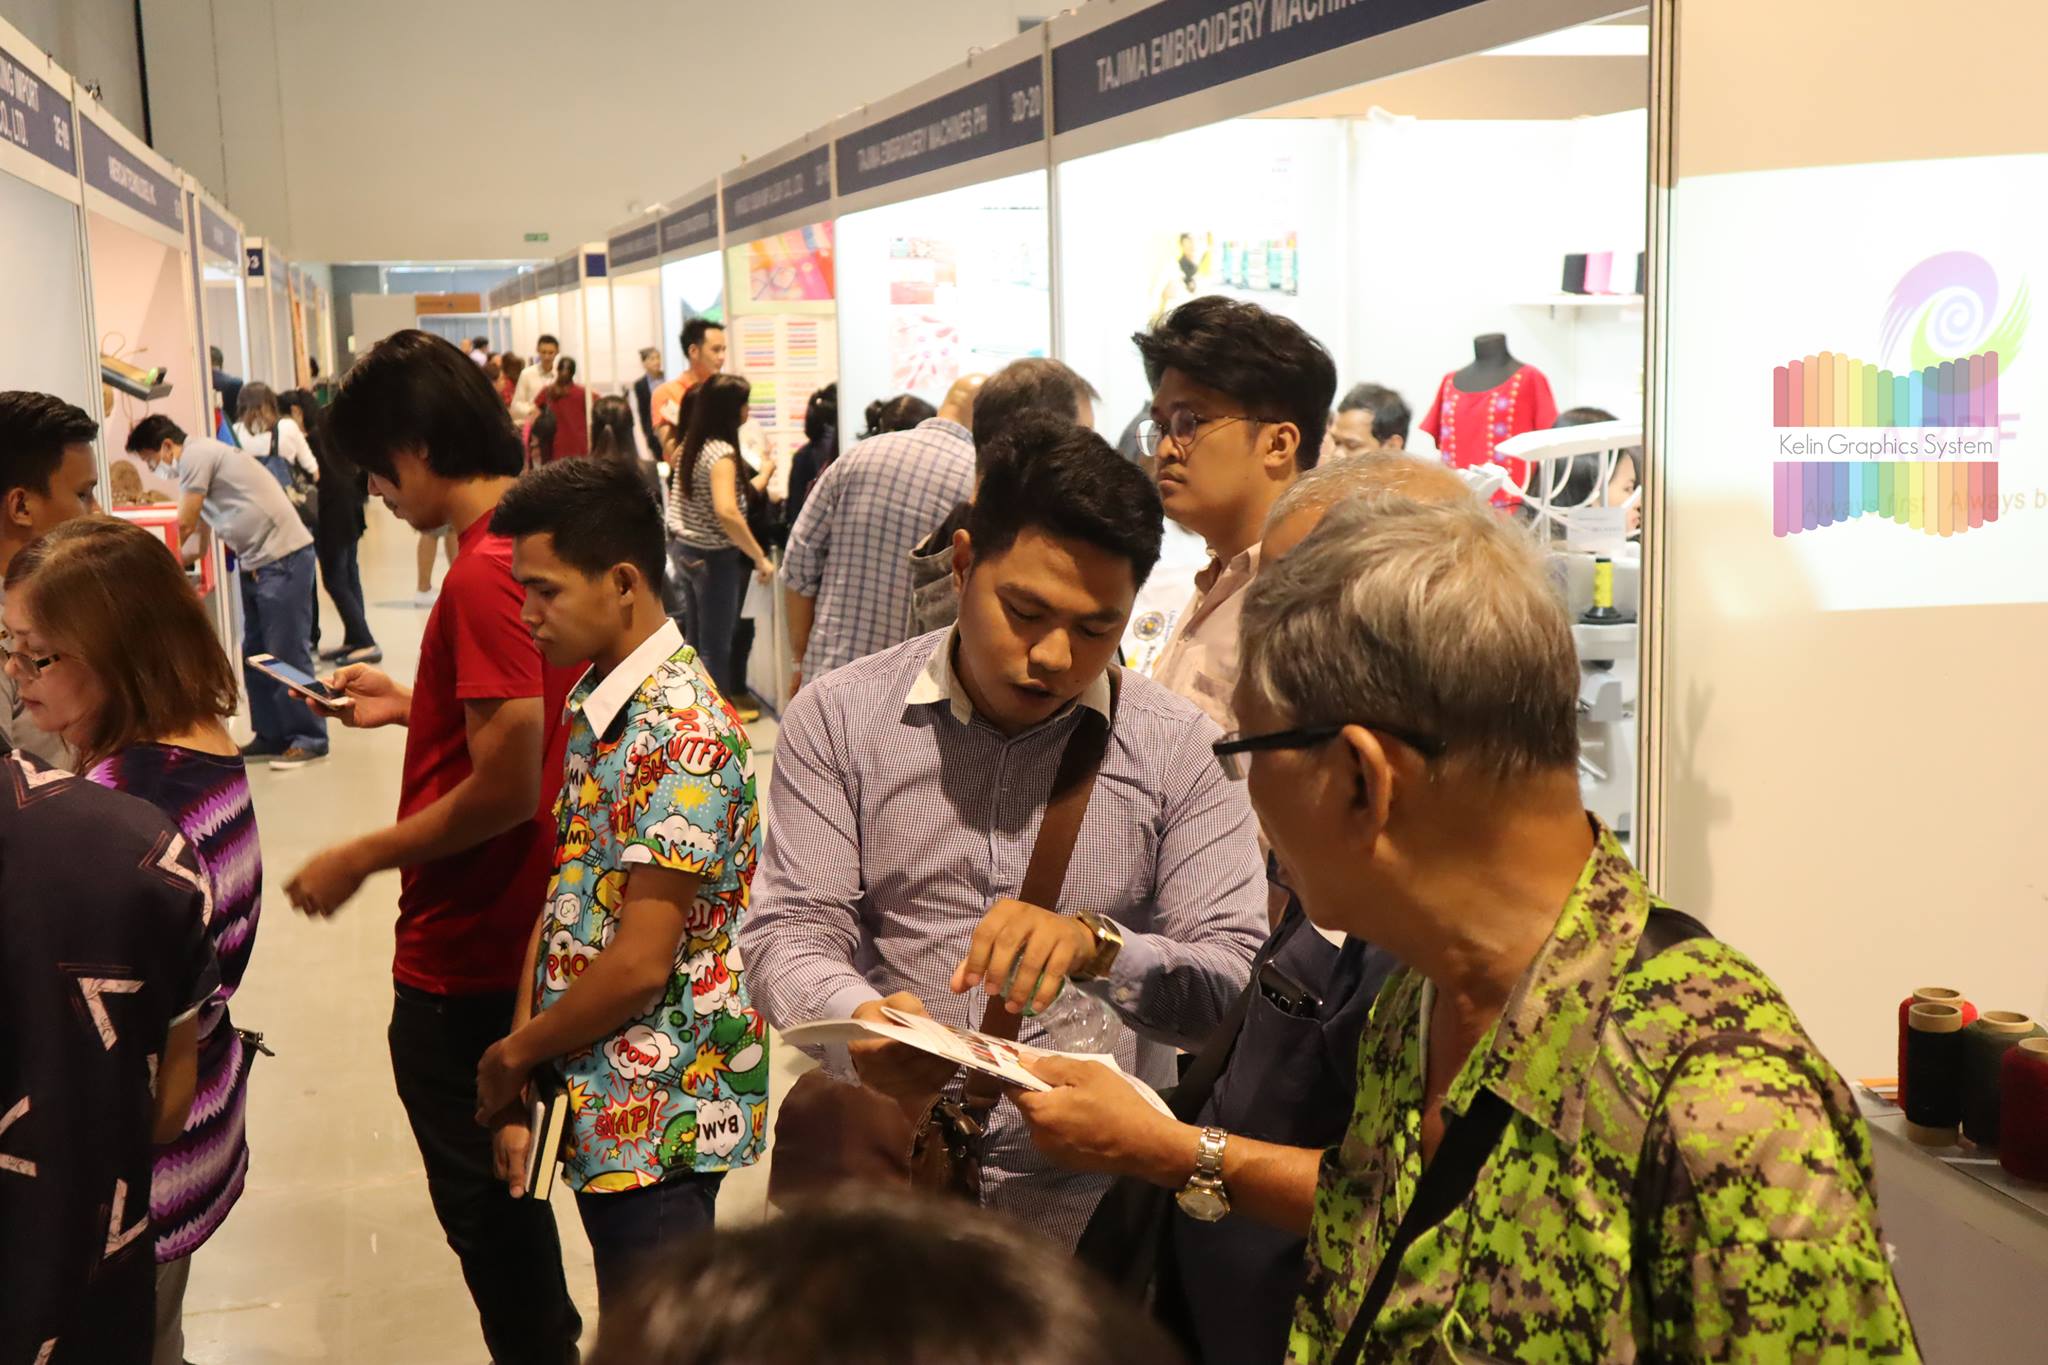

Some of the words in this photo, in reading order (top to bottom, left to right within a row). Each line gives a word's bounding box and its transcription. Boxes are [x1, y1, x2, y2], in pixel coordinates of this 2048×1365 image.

[1096, 43, 1149, 92] TAJIMA
[1151, 1, 1265, 75] EMBROIDERY
[616, 1037, 661, 1068] POW!
[595, 1098, 660, 1136] SNAP!
